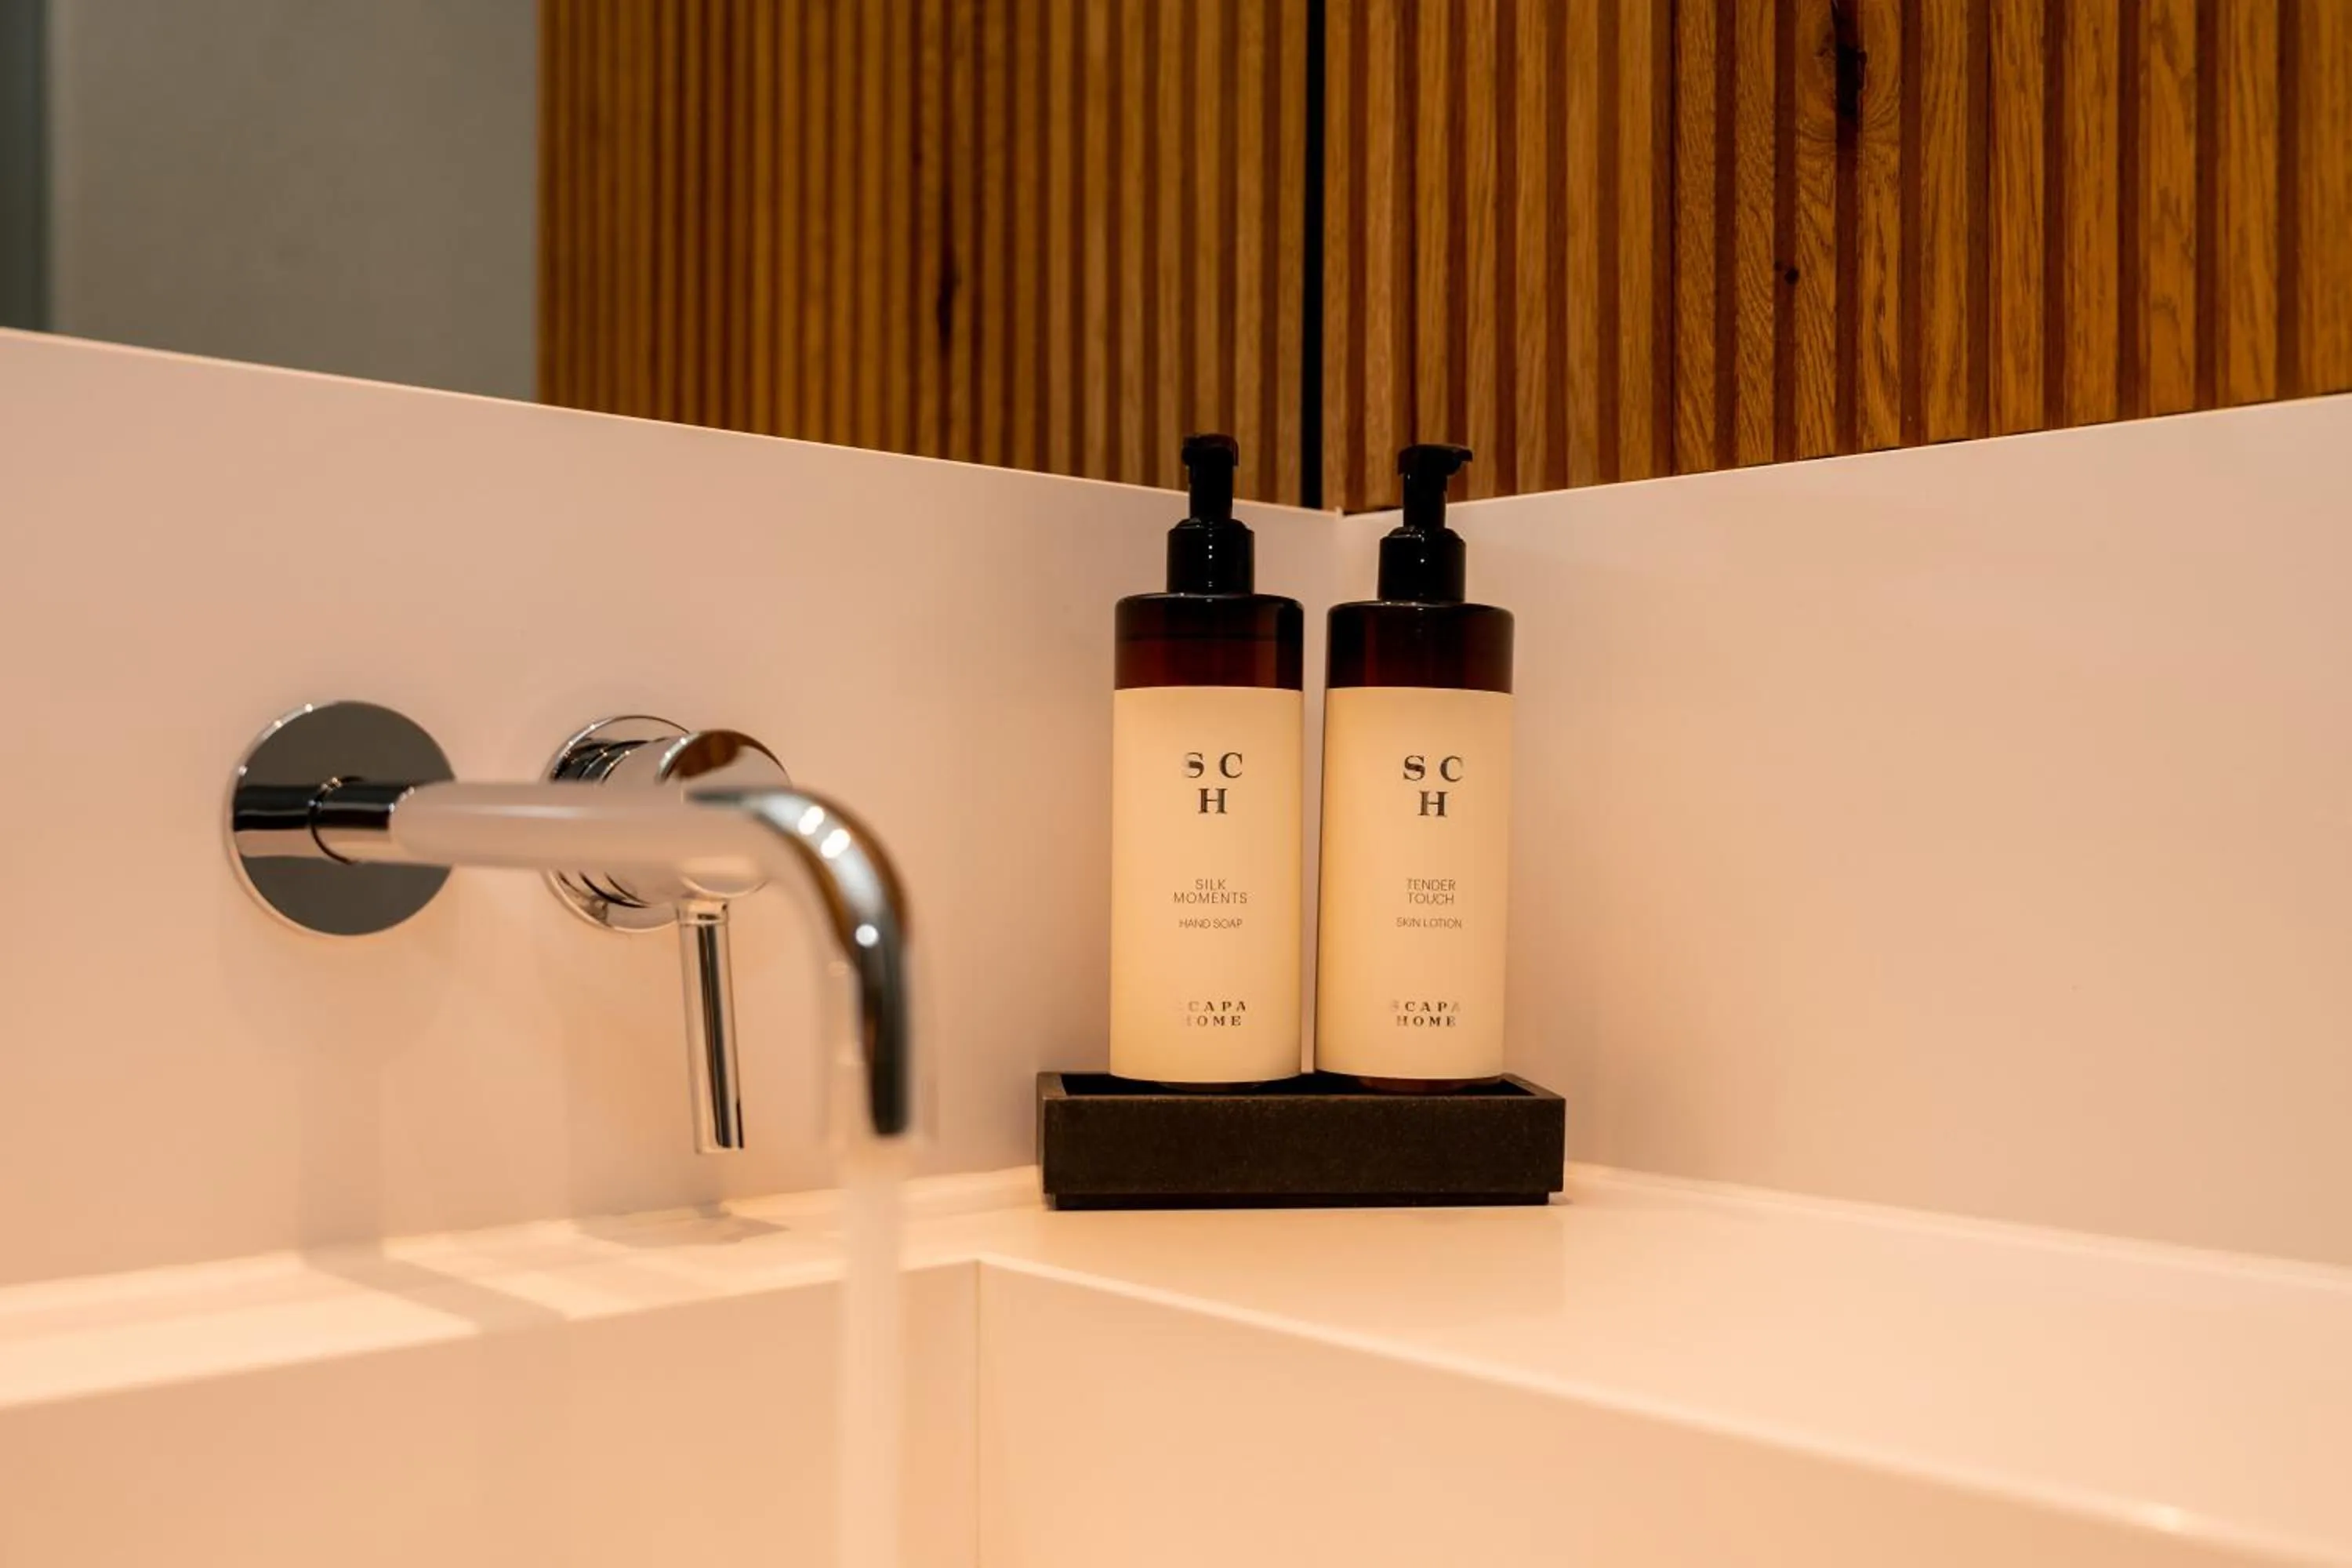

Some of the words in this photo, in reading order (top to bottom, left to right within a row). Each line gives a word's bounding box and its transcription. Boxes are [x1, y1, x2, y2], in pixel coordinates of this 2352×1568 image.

[1195, 878, 1226, 891] SILK
[1406, 878, 1456, 891] TENDER
[1174, 891, 1248, 904] MOMENTS
[1407, 892, 1455, 906] TOUCH
[1178, 918, 1211, 929] HAND
[1213, 918, 1243, 929] SOAP
[1396, 916, 1421, 927] SKIN
[1423, 918, 1462, 929] LOTION
[1179, 1000, 1246, 1012] CAPA
[1396, 1015, 1457, 1027] HOME
